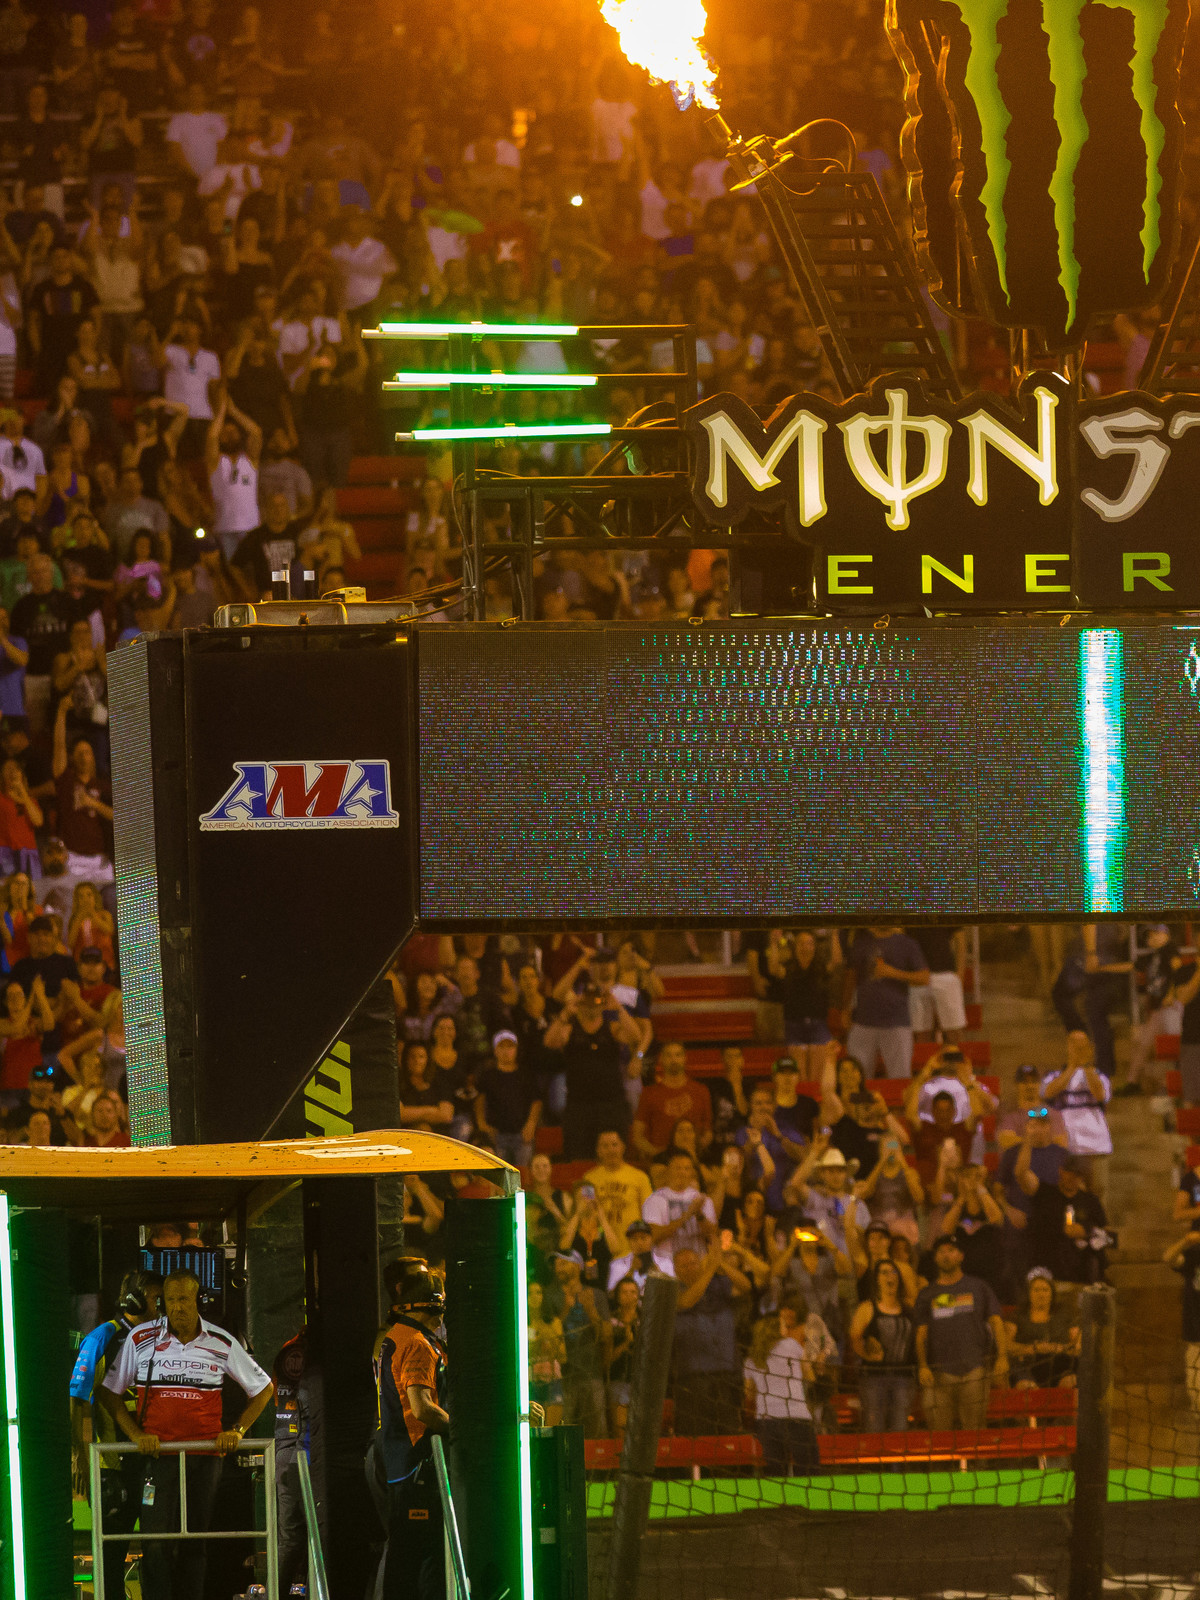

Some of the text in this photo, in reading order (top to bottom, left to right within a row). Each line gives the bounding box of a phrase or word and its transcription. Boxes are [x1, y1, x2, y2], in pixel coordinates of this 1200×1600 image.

[202, 762, 397, 821] AMA
[202, 818, 398, 829] AMERICAN MOTORCYCLIST ASSOCIATION
[160, 1391, 203, 1400] HONDA
